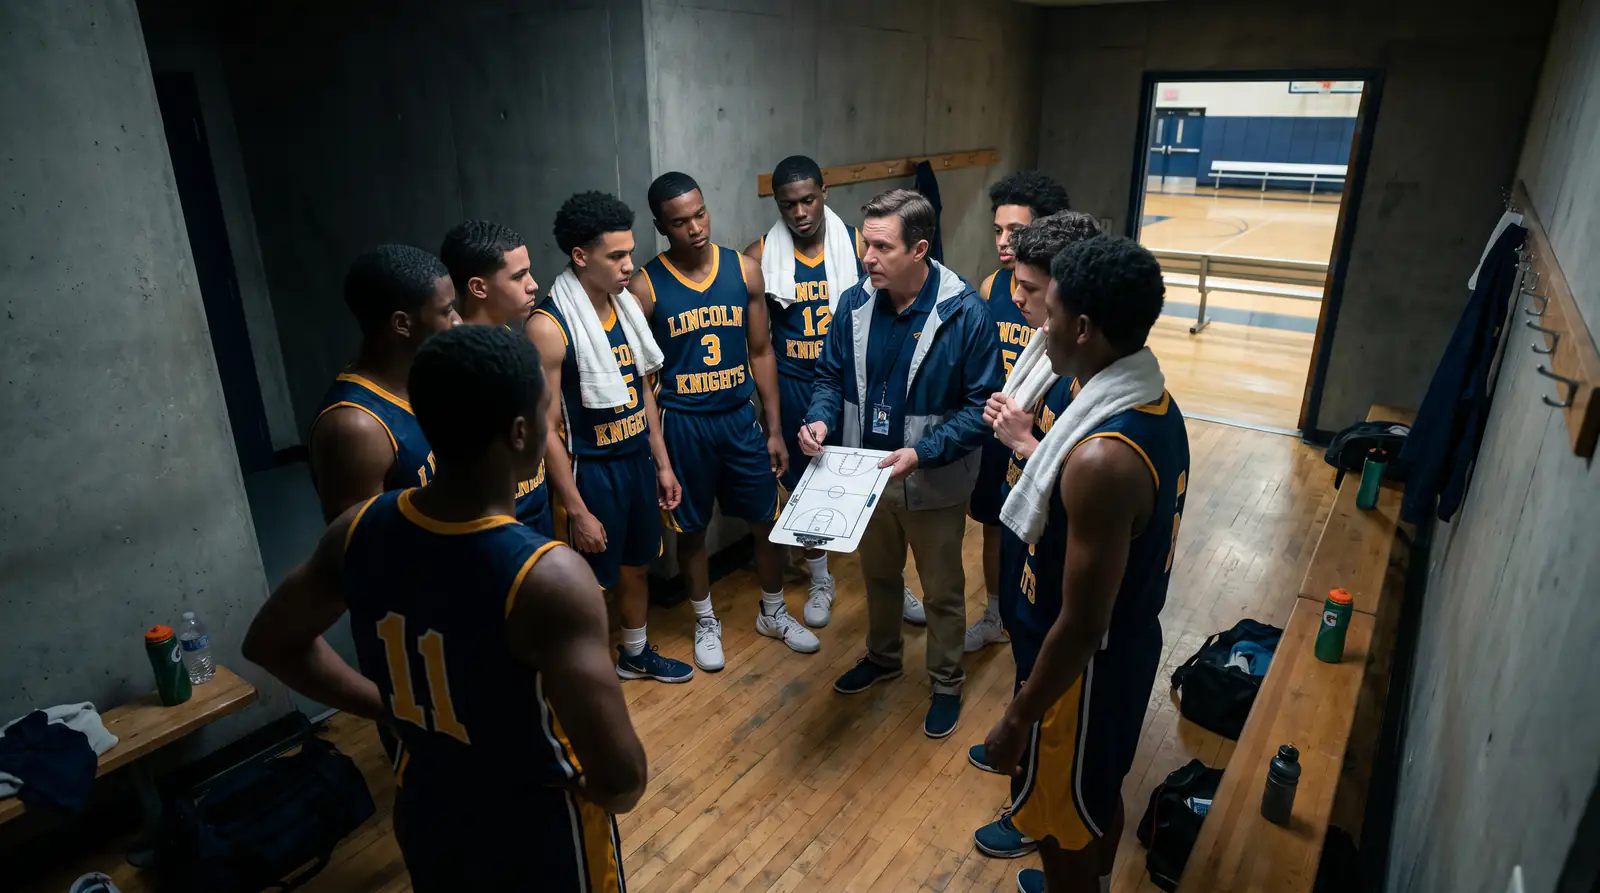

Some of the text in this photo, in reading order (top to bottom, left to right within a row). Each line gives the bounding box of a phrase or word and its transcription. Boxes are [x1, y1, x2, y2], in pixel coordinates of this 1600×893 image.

[667, 305, 743, 338] LINCOLN
[802, 305, 832, 337] 12
[700, 333, 722, 367] 3
[676, 364, 746, 394] KNIGHTS
[375, 610, 472, 746] 11
